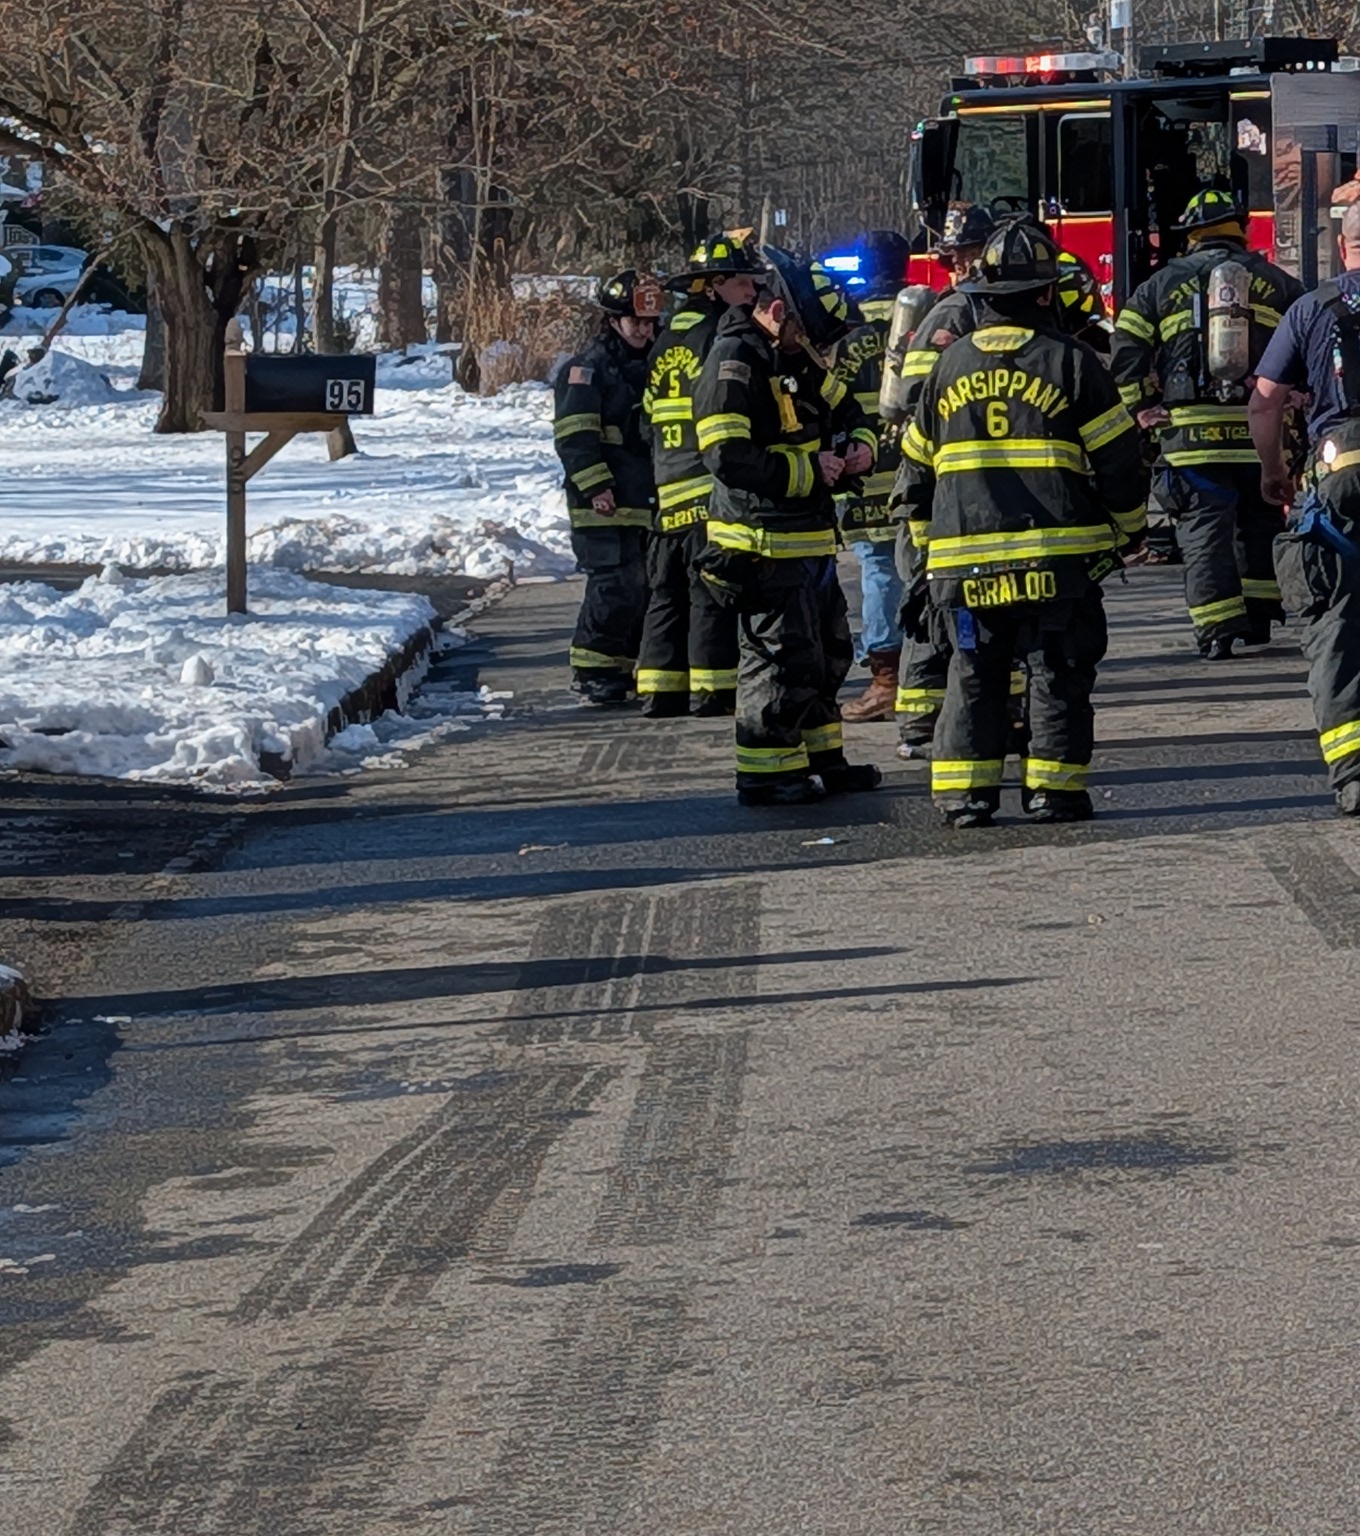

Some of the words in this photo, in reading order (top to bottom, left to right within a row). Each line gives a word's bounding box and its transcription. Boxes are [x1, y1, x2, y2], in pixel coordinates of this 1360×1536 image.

[329, 380, 362, 411] 95
[668, 368, 681, 399] 5
[937, 368, 1070, 423] PARSIPPANY
[986, 400, 1009, 438] 6
[962, 570, 1057, 609] GIRALDO
